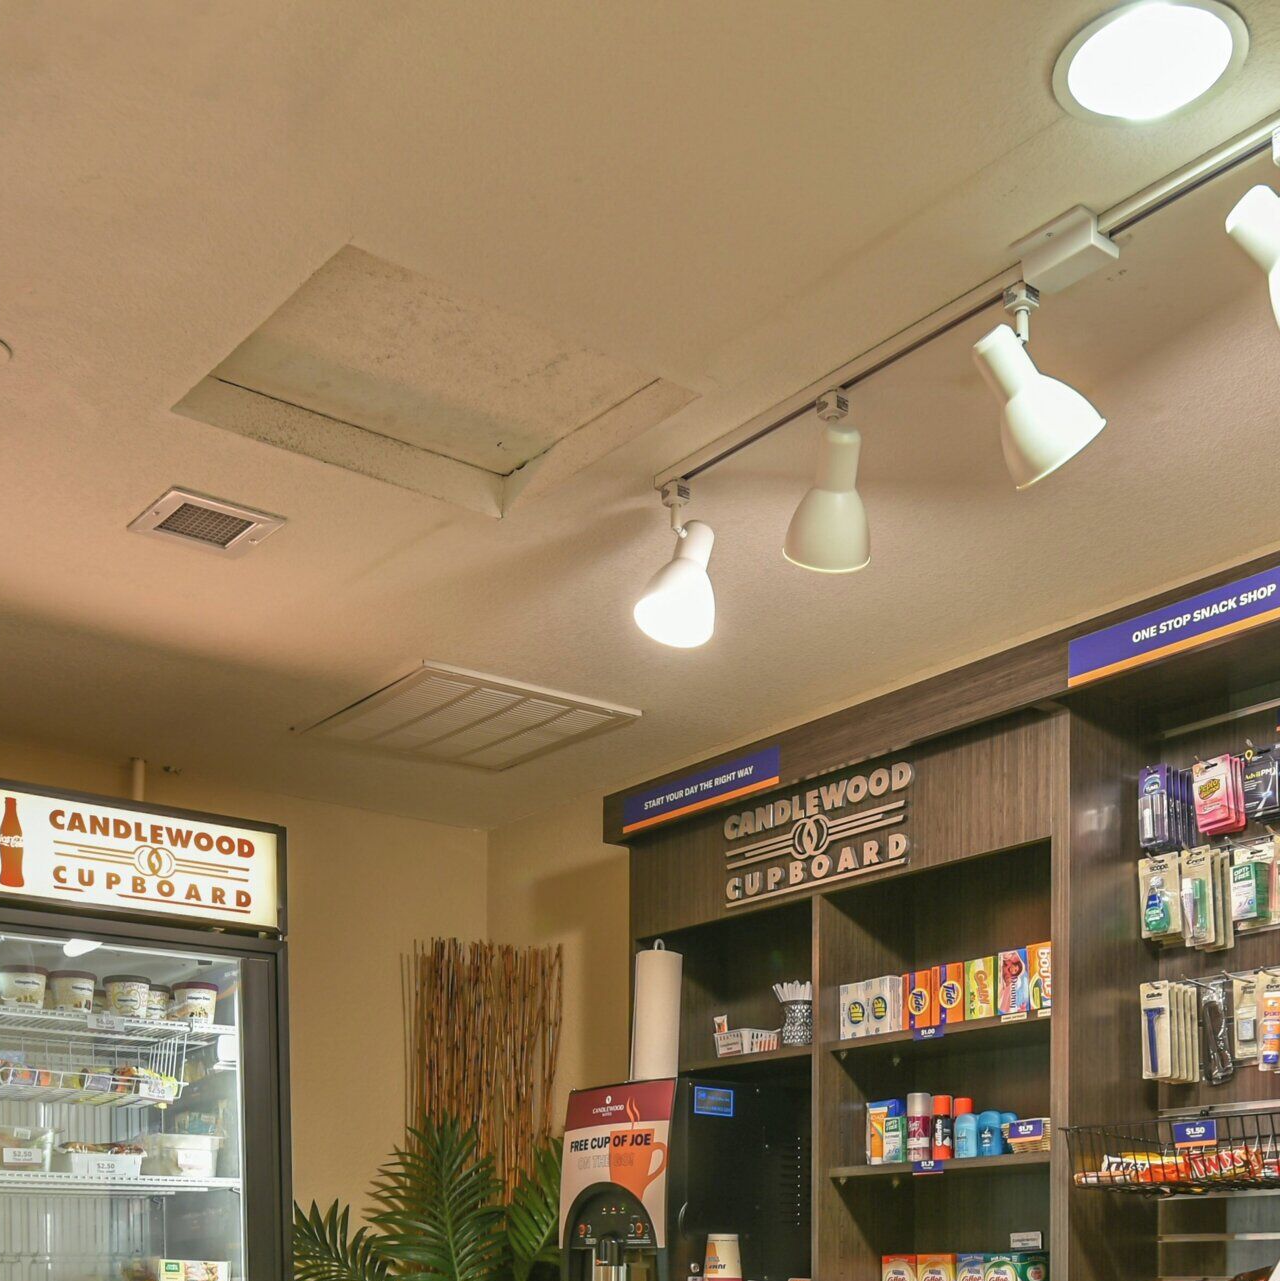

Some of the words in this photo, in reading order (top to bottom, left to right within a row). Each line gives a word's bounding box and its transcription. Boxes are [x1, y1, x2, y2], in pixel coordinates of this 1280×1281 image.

[1132, 626, 1157, 643] ONE
[1159, 613, 1191, 634] STOP
[1193, 597, 1237, 623] SNACK
[1239, 584, 1277, 606] SHOP
[644, 799, 664, 810] START
[666, 789, 684, 806] YOUR
[685, 785, 698, 799] DAY
[700, 781, 713, 795] THE
[715, 773, 736, 789] RIGHT
[737, 766, 754, 780] WAY
[724, 762, 914, 840] CANDLEWOOD
[49, 810, 255, 858] CANDLEWOOD
[53, 866, 252, 908] CUPBOARD
[726, 833, 909, 900] CUPBOARD
[943, 983, 956, 1005] Tide
[593, 1105, 624, 1114] CANDLEWOOD
[570, 1139, 589, 1152] FREE
[591, 1136, 610, 1149] CUP
[613, 1135, 628, 1147] OF
[630, 1134, 651, 1146] JOE
[1185, 1126, 1205, 1136] $1.50
[1191, 1149, 1243, 1178] TWIX
